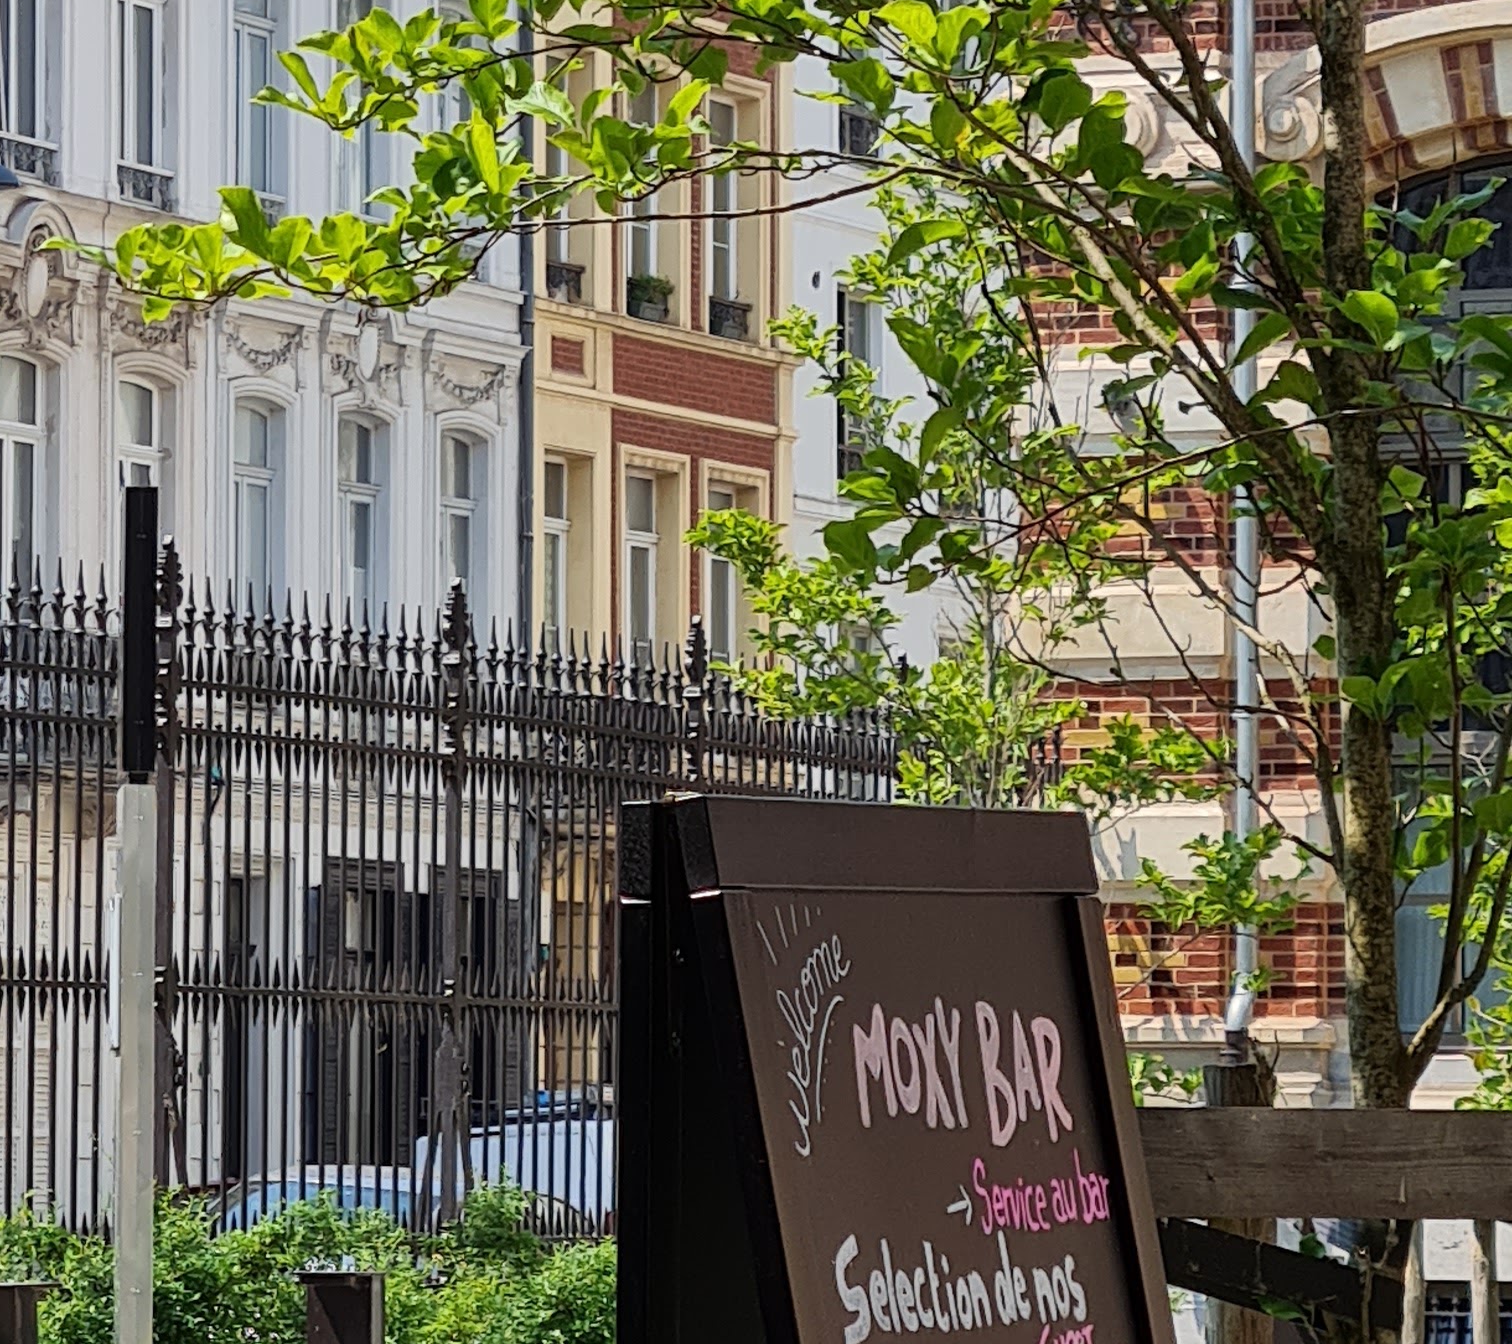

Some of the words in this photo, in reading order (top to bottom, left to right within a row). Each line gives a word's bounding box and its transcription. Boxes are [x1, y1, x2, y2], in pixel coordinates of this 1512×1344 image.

[853, 996, 969, 1129] MOXY
[975, 1000, 1074, 1147] BAR
[972, 1157, 1051, 1235] Service
[1050, 1177, 1078, 1223] au
[1074, 1147, 1111, 1224] bar
[995, 1229, 1032, 1326] de
[1033, 1254, 1087, 1324] nos
